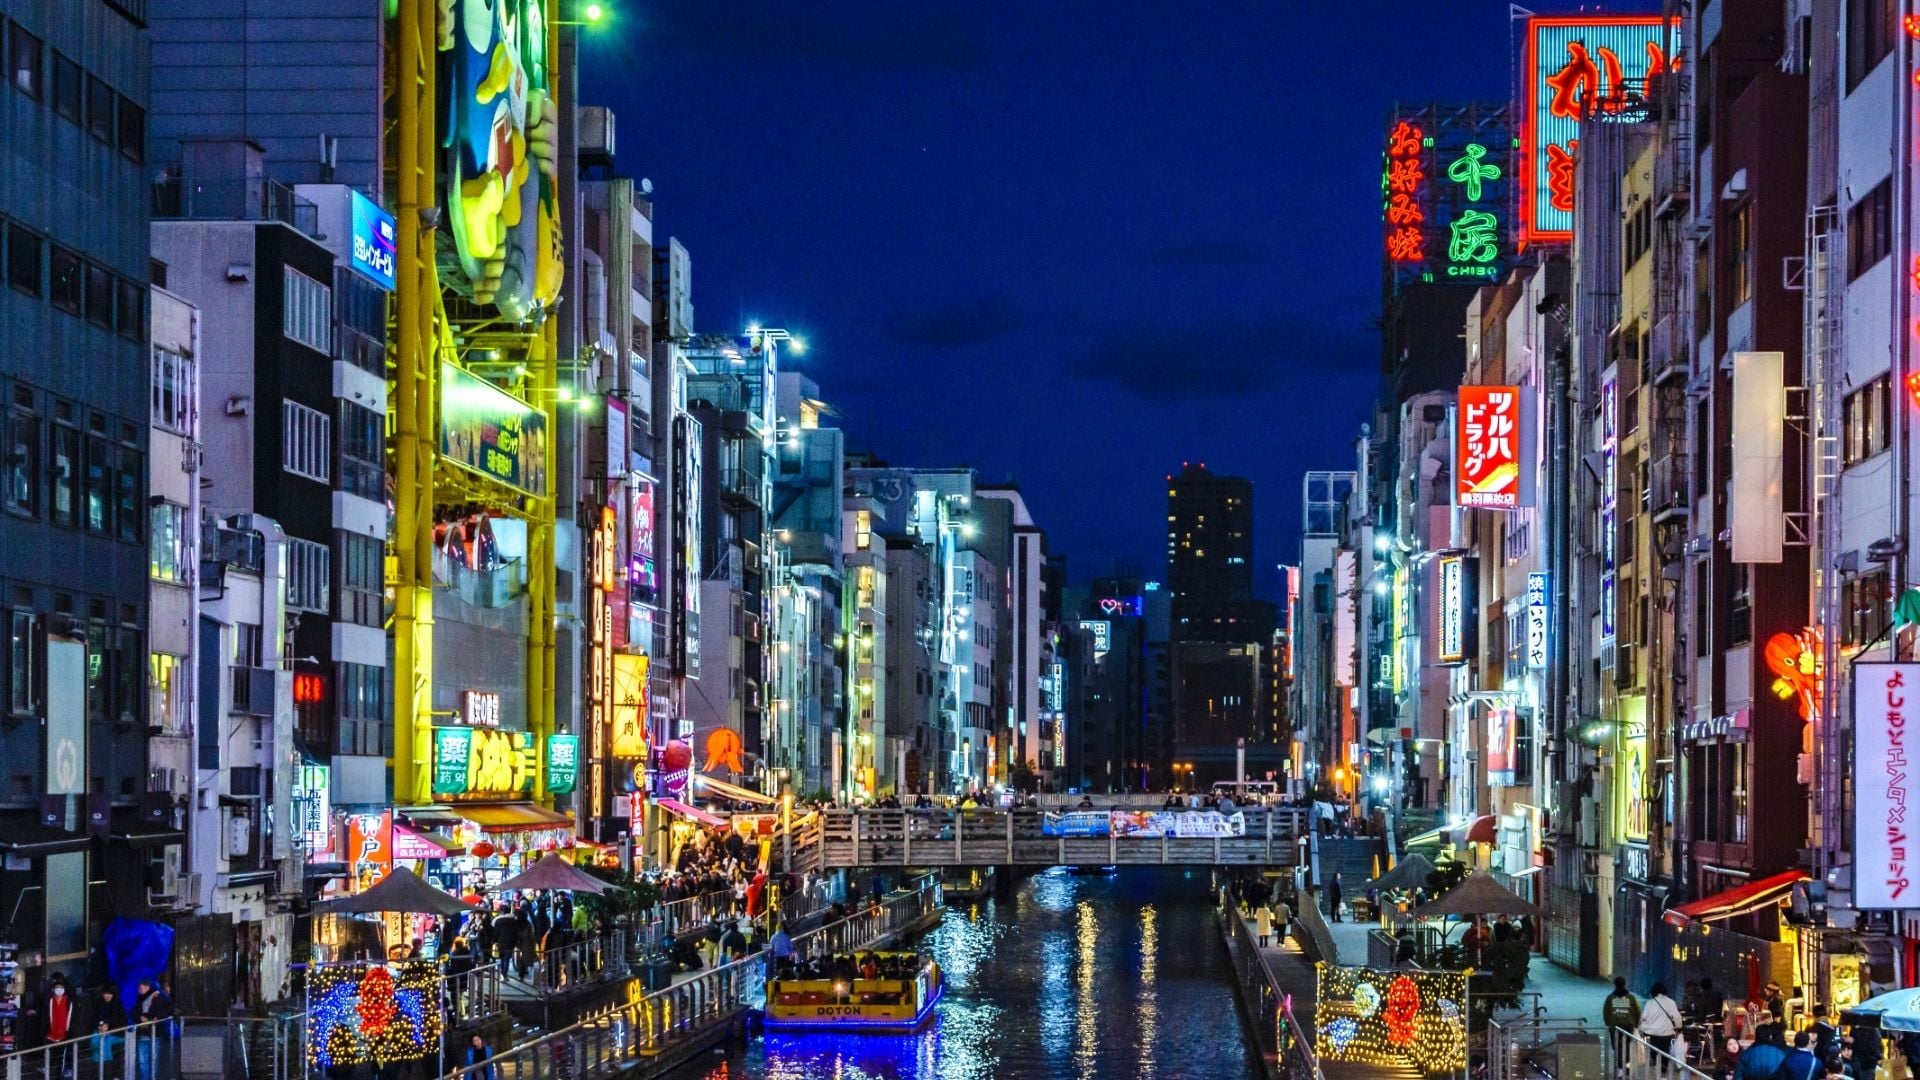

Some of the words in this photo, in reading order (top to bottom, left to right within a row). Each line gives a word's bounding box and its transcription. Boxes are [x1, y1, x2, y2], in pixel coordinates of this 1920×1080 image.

[1388, 121, 1424, 261] お好み焼
[1449, 143, 1501, 262] 千房
[1448, 266, 1498, 276] CHIBO
[1464, 403, 1487, 477] ドラッグ
[1486, 392, 1513, 459] ツルハ
[624, 694, 636, 736] 焼肉
[440, 736, 469, 763] 薬
[550, 742, 575, 766] 薬
[1886, 671, 1909, 901] よしもとエンタメショップ
[816, 1006, 861, 1016] DOTON
